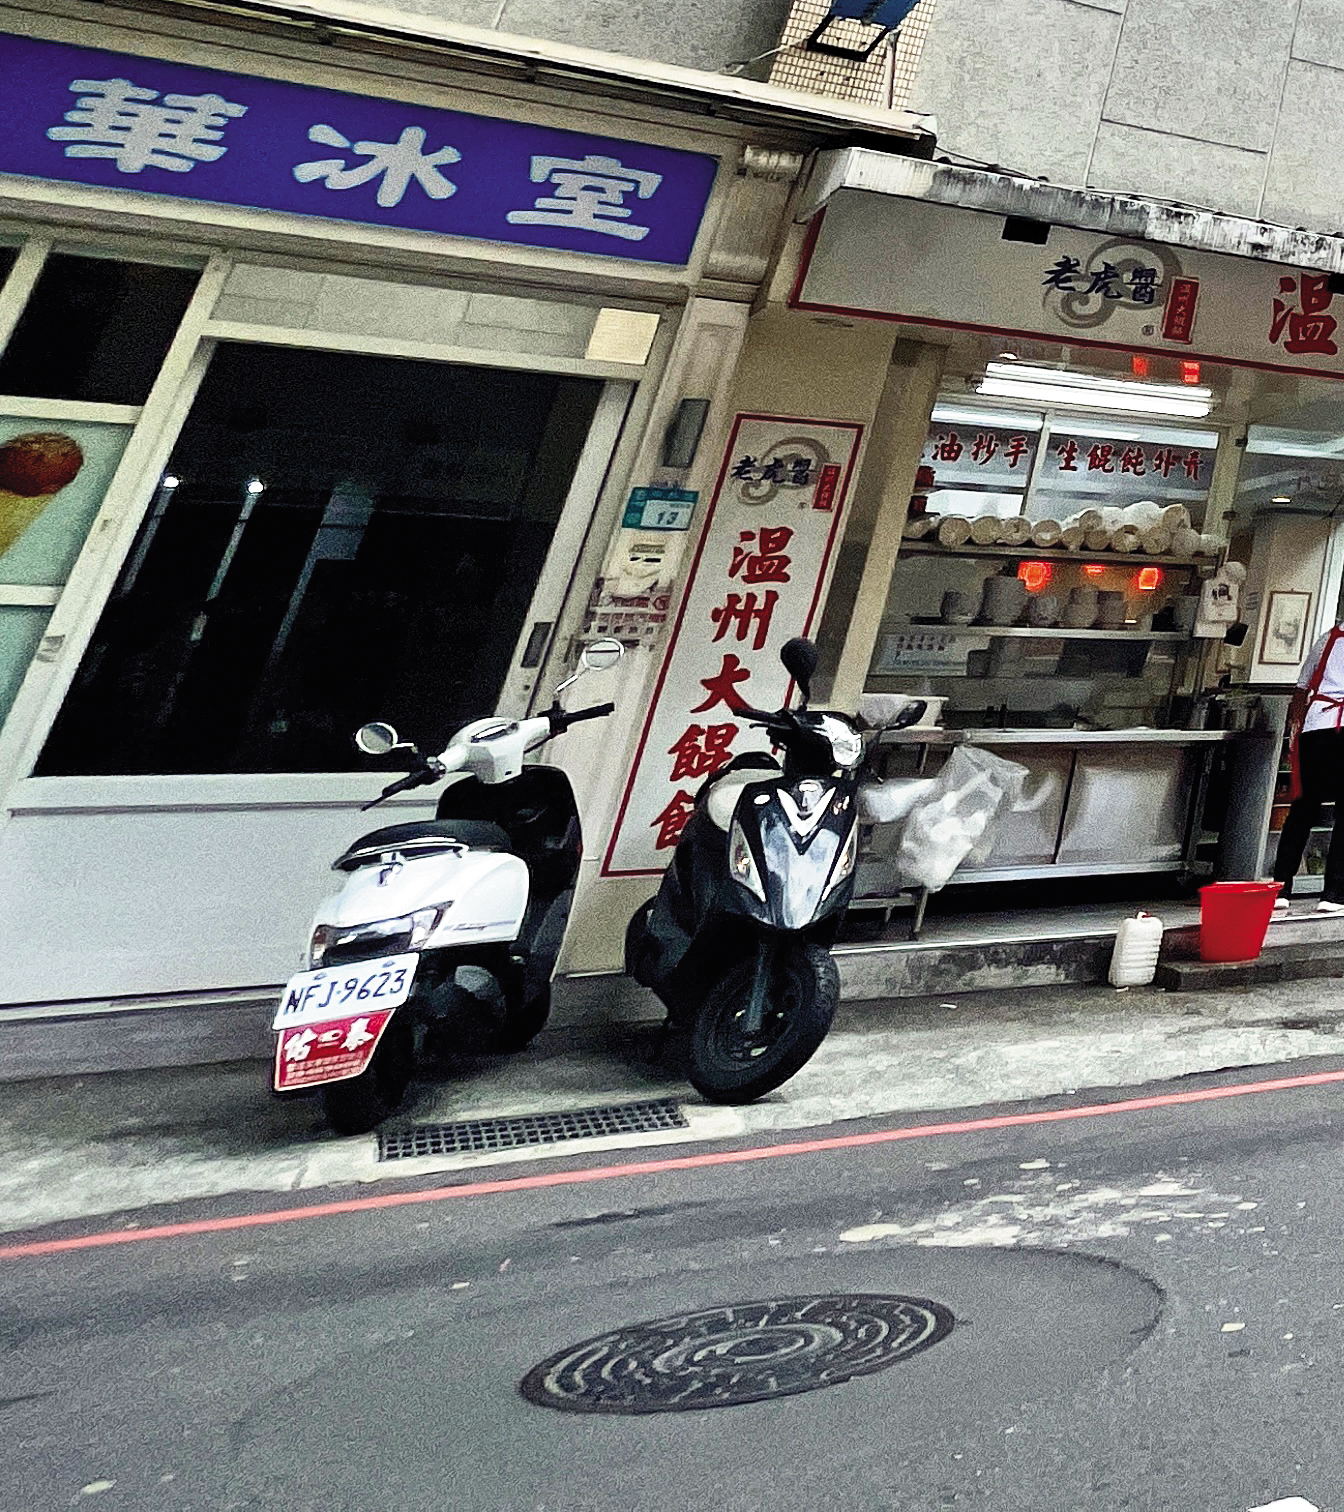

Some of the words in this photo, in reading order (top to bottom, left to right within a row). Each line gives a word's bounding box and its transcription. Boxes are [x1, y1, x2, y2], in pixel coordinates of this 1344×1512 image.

[47, 78, 663, 241] 華冰室
[919, 433, 1030, 469] 油抄手
[283, 968, 408, 1016] NFJ-9623
